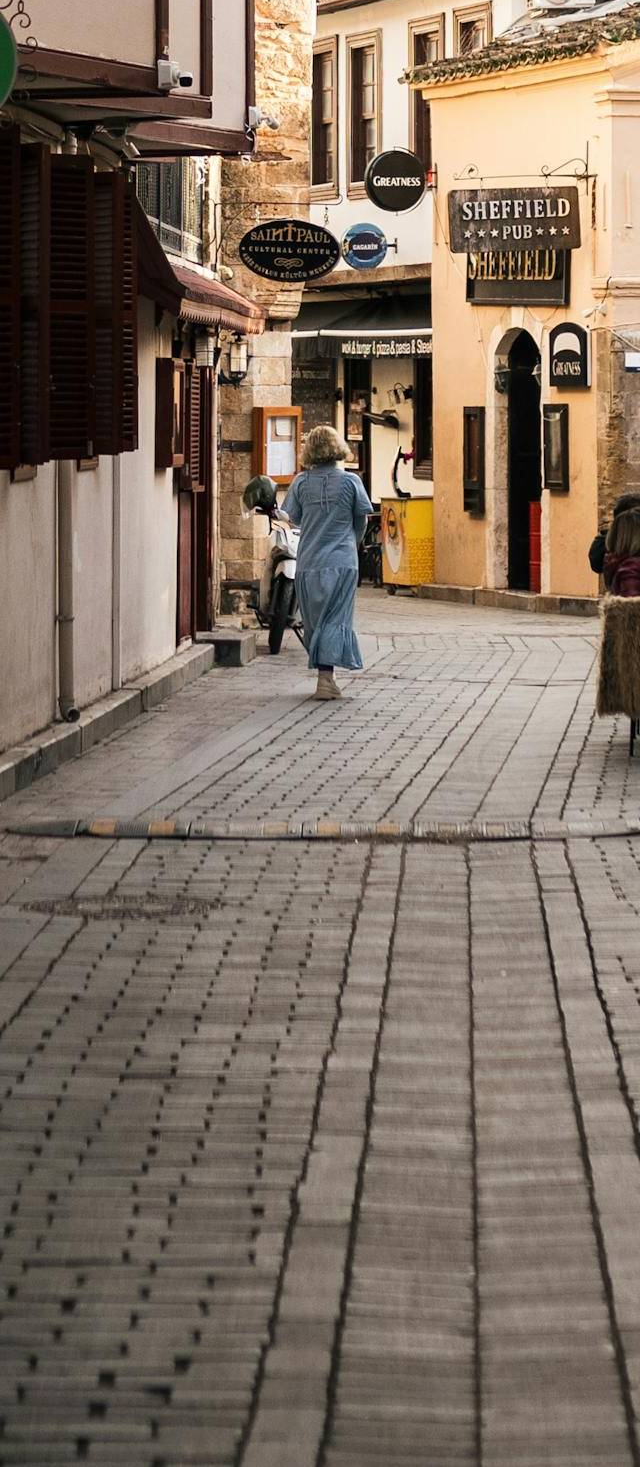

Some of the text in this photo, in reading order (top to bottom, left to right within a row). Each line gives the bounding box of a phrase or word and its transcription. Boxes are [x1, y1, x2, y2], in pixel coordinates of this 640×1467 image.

[462, 198, 571, 221] SHEFFIELD
[251, 223, 331, 244] SAINT PAUL
[502, 225, 533, 240] PUB
[249, 246, 330, 255] CULTURAL CENTER
[468, 249, 556, 280] SHEFFIELD
